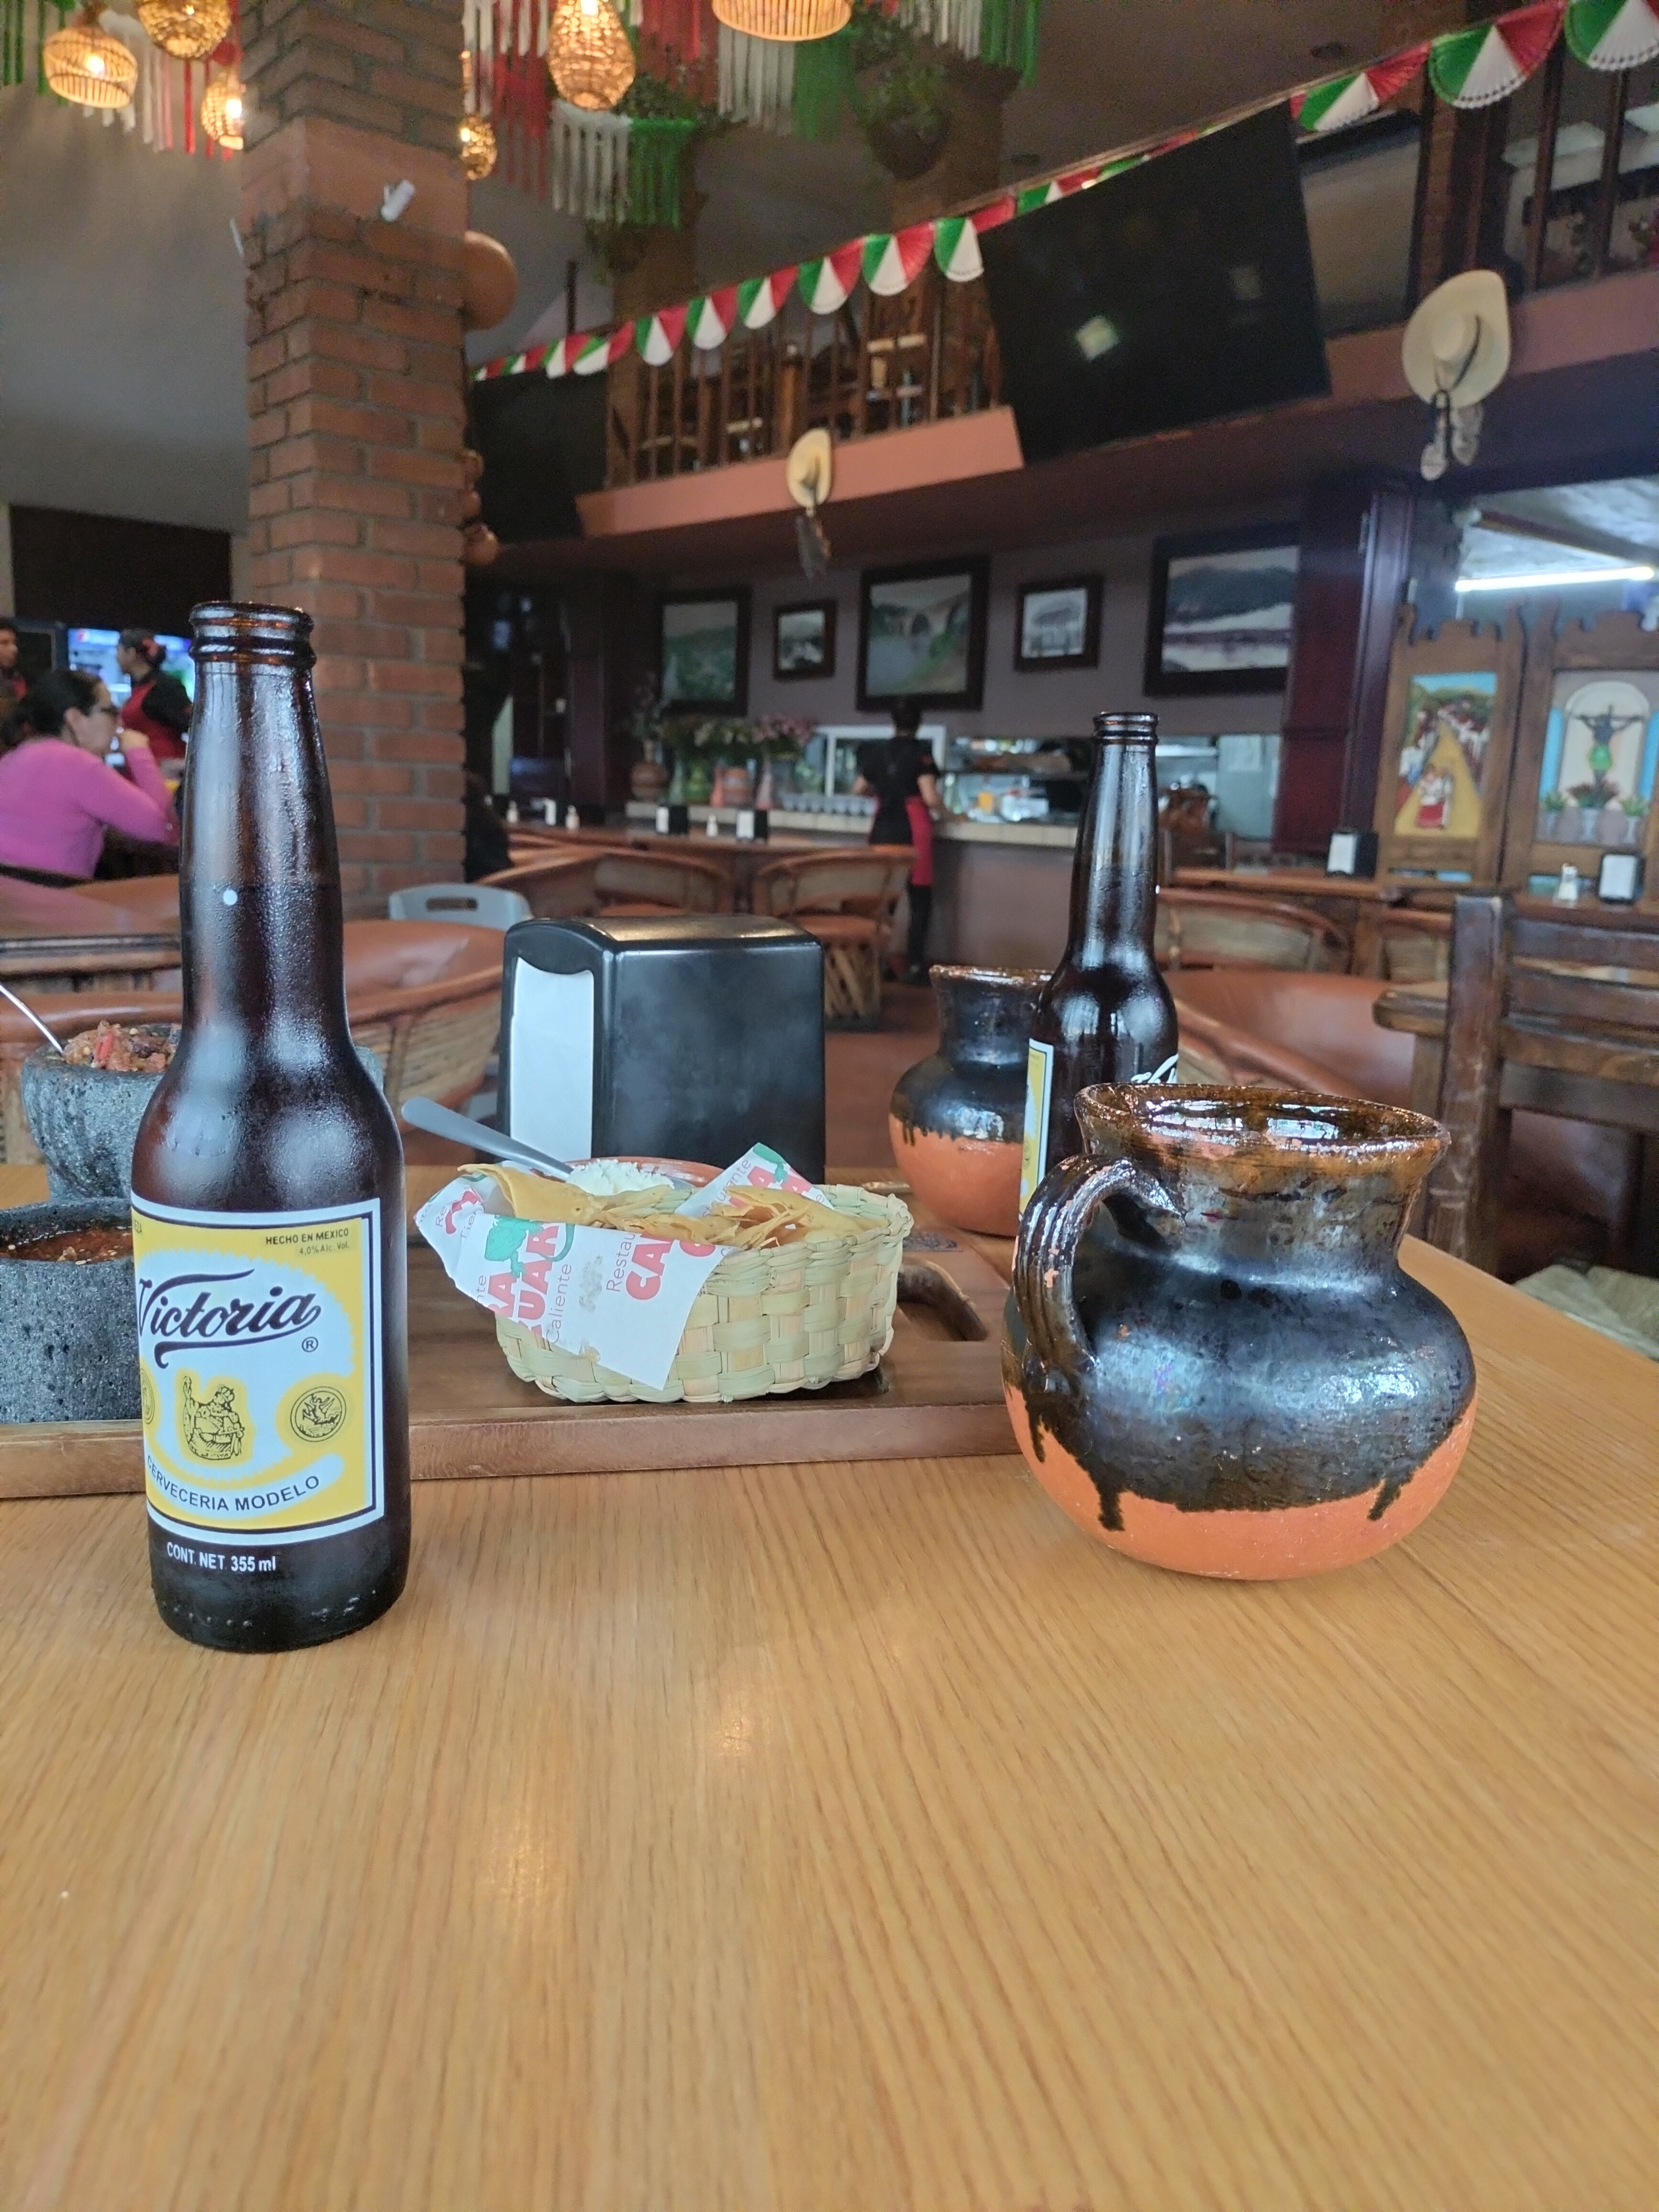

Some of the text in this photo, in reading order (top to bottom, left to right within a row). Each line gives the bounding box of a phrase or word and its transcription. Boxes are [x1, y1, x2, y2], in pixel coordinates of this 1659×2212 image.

[265, 1228, 349, 1245] HECHO EN MEXICO
[625, 1234, 675, 1301] CA
[138, 1269, 321, 1369] Victoria
[546, 1263, 572, 1343] Caliente
[147, 1455, 320, 1511] CERVECERIA MODELO
[230, 1555, 255, 1572] 355
[258, 1556, 276, 1572] ml
